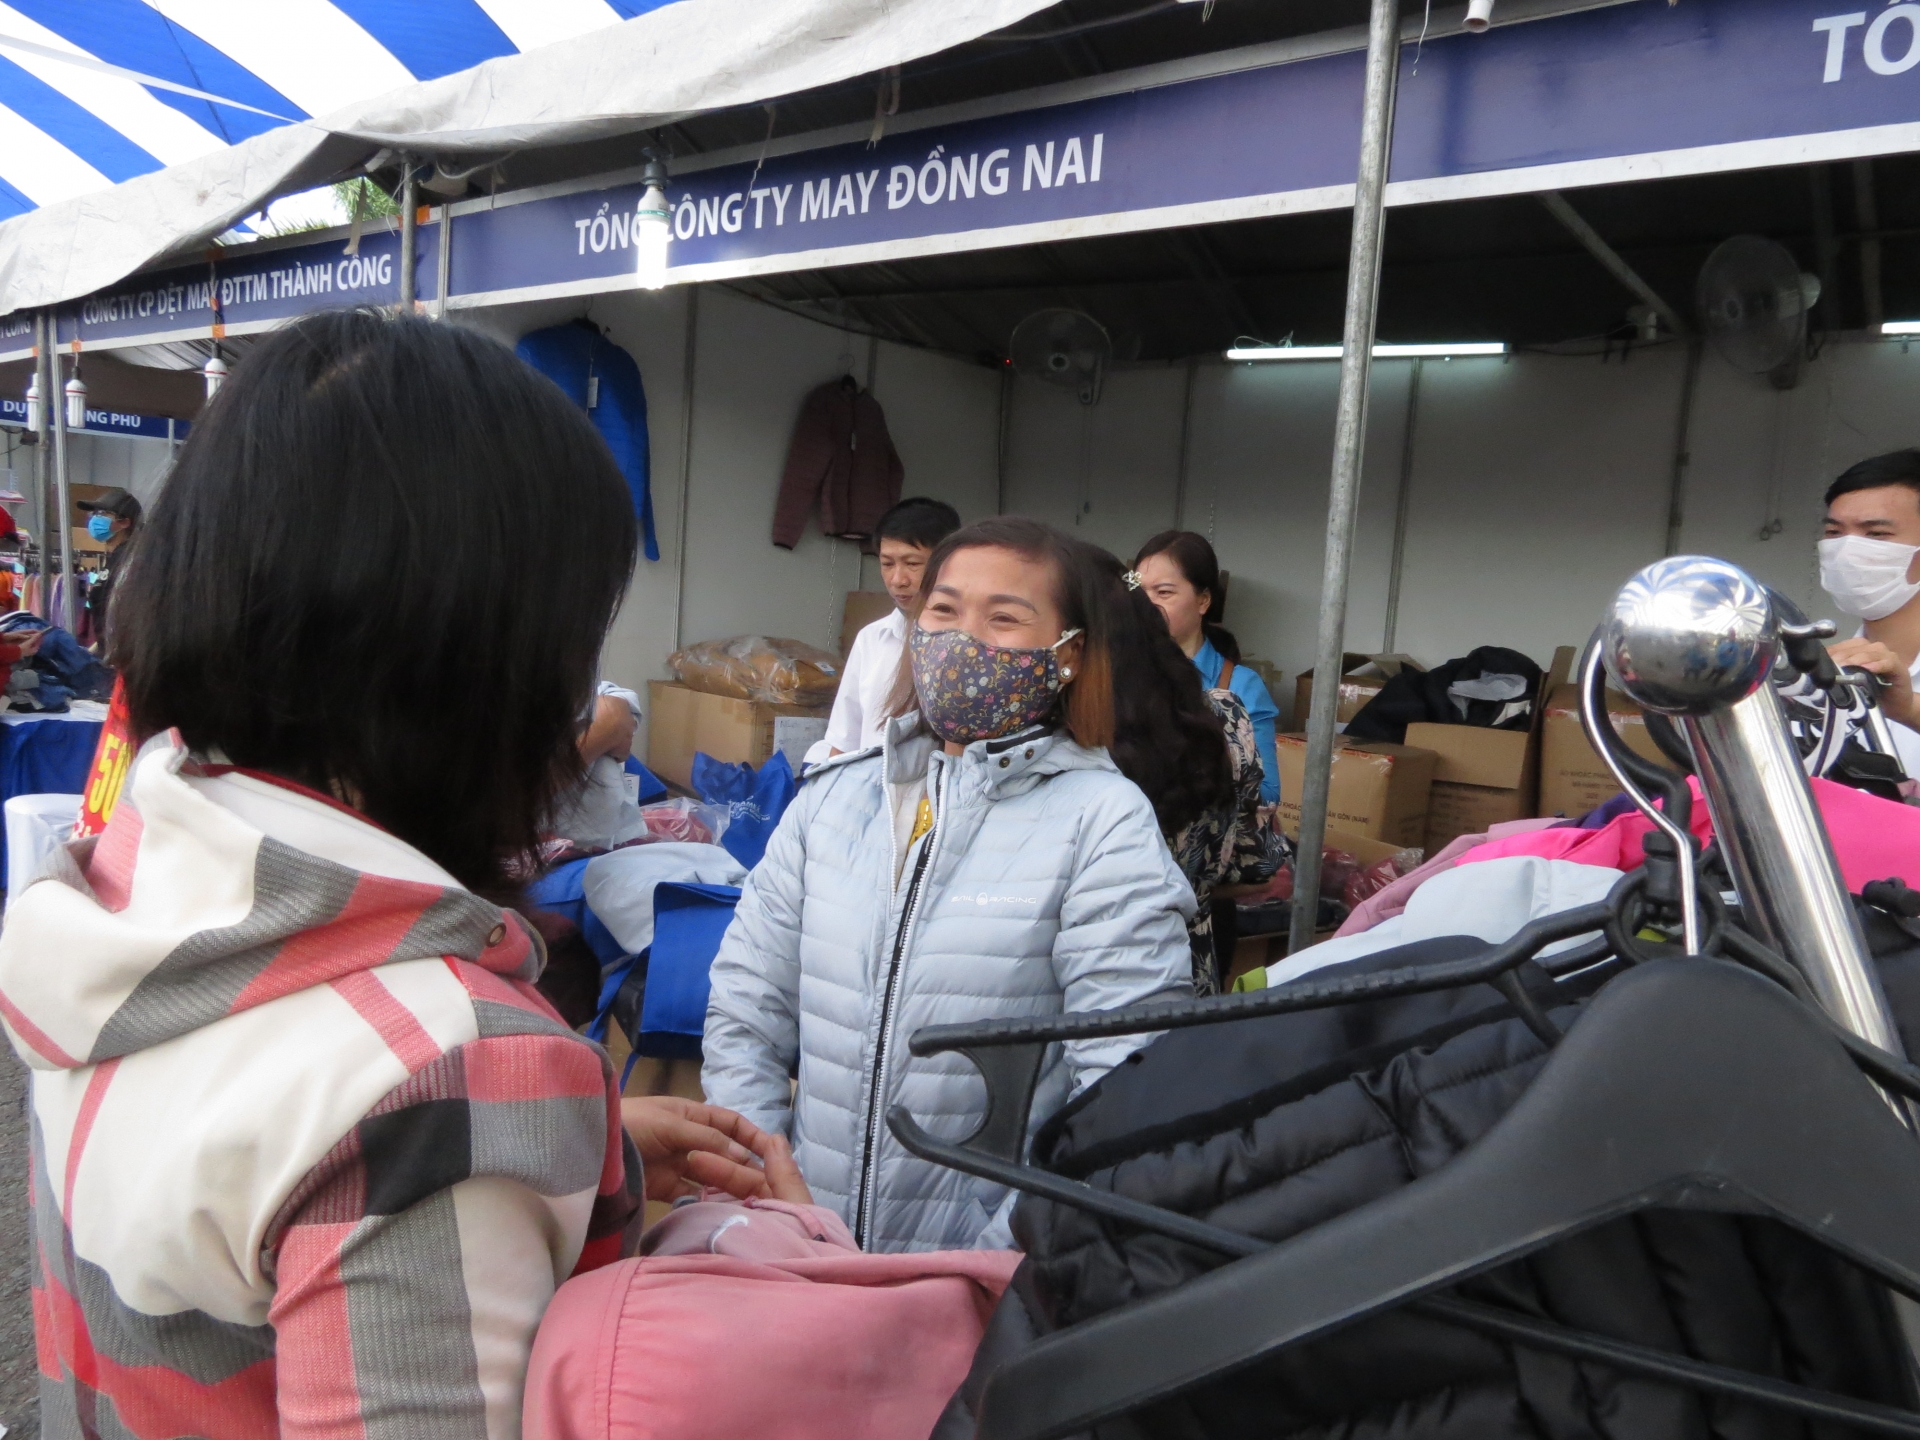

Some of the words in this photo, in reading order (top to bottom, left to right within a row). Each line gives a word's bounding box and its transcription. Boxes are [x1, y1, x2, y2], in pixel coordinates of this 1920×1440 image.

[751, 183, 794, 229] TY
[800, 169, 880, 223] MAY
[886, 145, 1010, 210] ĐỒNG
[1022, 133, 1104, 192] NAI
[119, 293, 135, 320] TY
[138, 290, 155, 318] CP
[157, 282, 185, 321] DỆT
[187, 279, 219, 311] MAY
[221, 273, 268, 306] ĐTTM
[271, 261, 332, 299] THÀNH
[337, 254, 392, 291] CÔNG
[987, 896, 1037, 904] RACING
